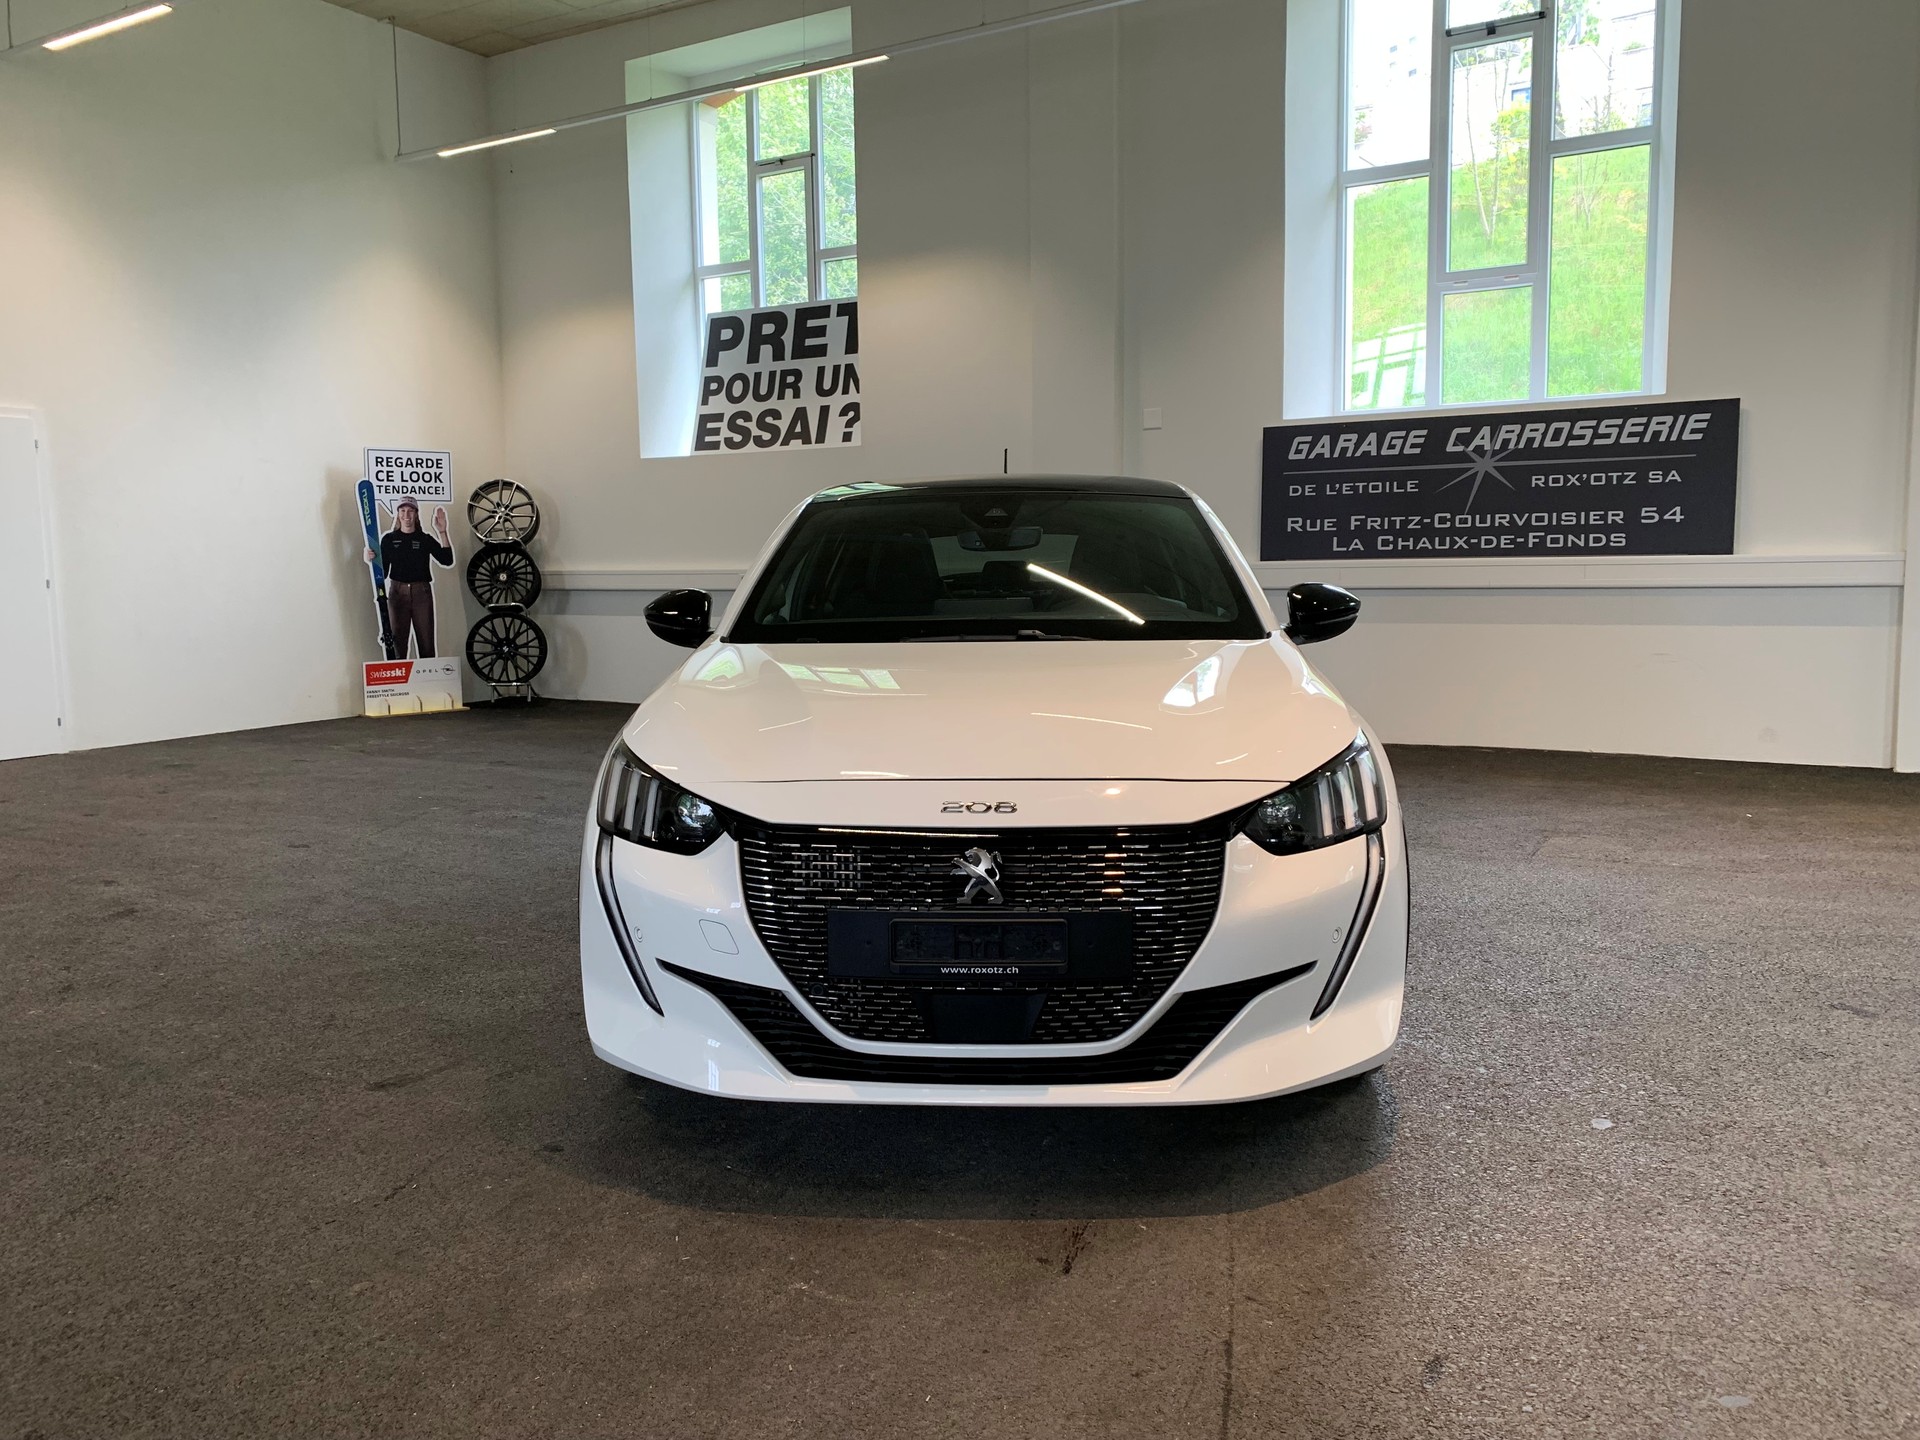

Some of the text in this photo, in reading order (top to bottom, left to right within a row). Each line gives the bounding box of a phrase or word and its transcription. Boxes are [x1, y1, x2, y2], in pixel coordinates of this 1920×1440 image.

[705, 302, 858, 368] PRET
[701, 363, 860, 406] POUR UN
[694, 404, 831, 452] ESSAI
[1288, 412, 1712, 460] GARAGE CARROSSERIE
[375, 456, 443, 469] REGARDE
[375, 470, 443, 483] CE LOOK
[1531, 470, 1682, 487] ROX'OTZ SA
[376, 485, 445, 495] TENDANCE!
[1289, 480, 1419, 496] DE L'ETOILE
[1640, 506, 1685, 523] 54
[940, 801, 1018, 814] 208
[940, 966, 1019, 974] www.roxotz.ch
